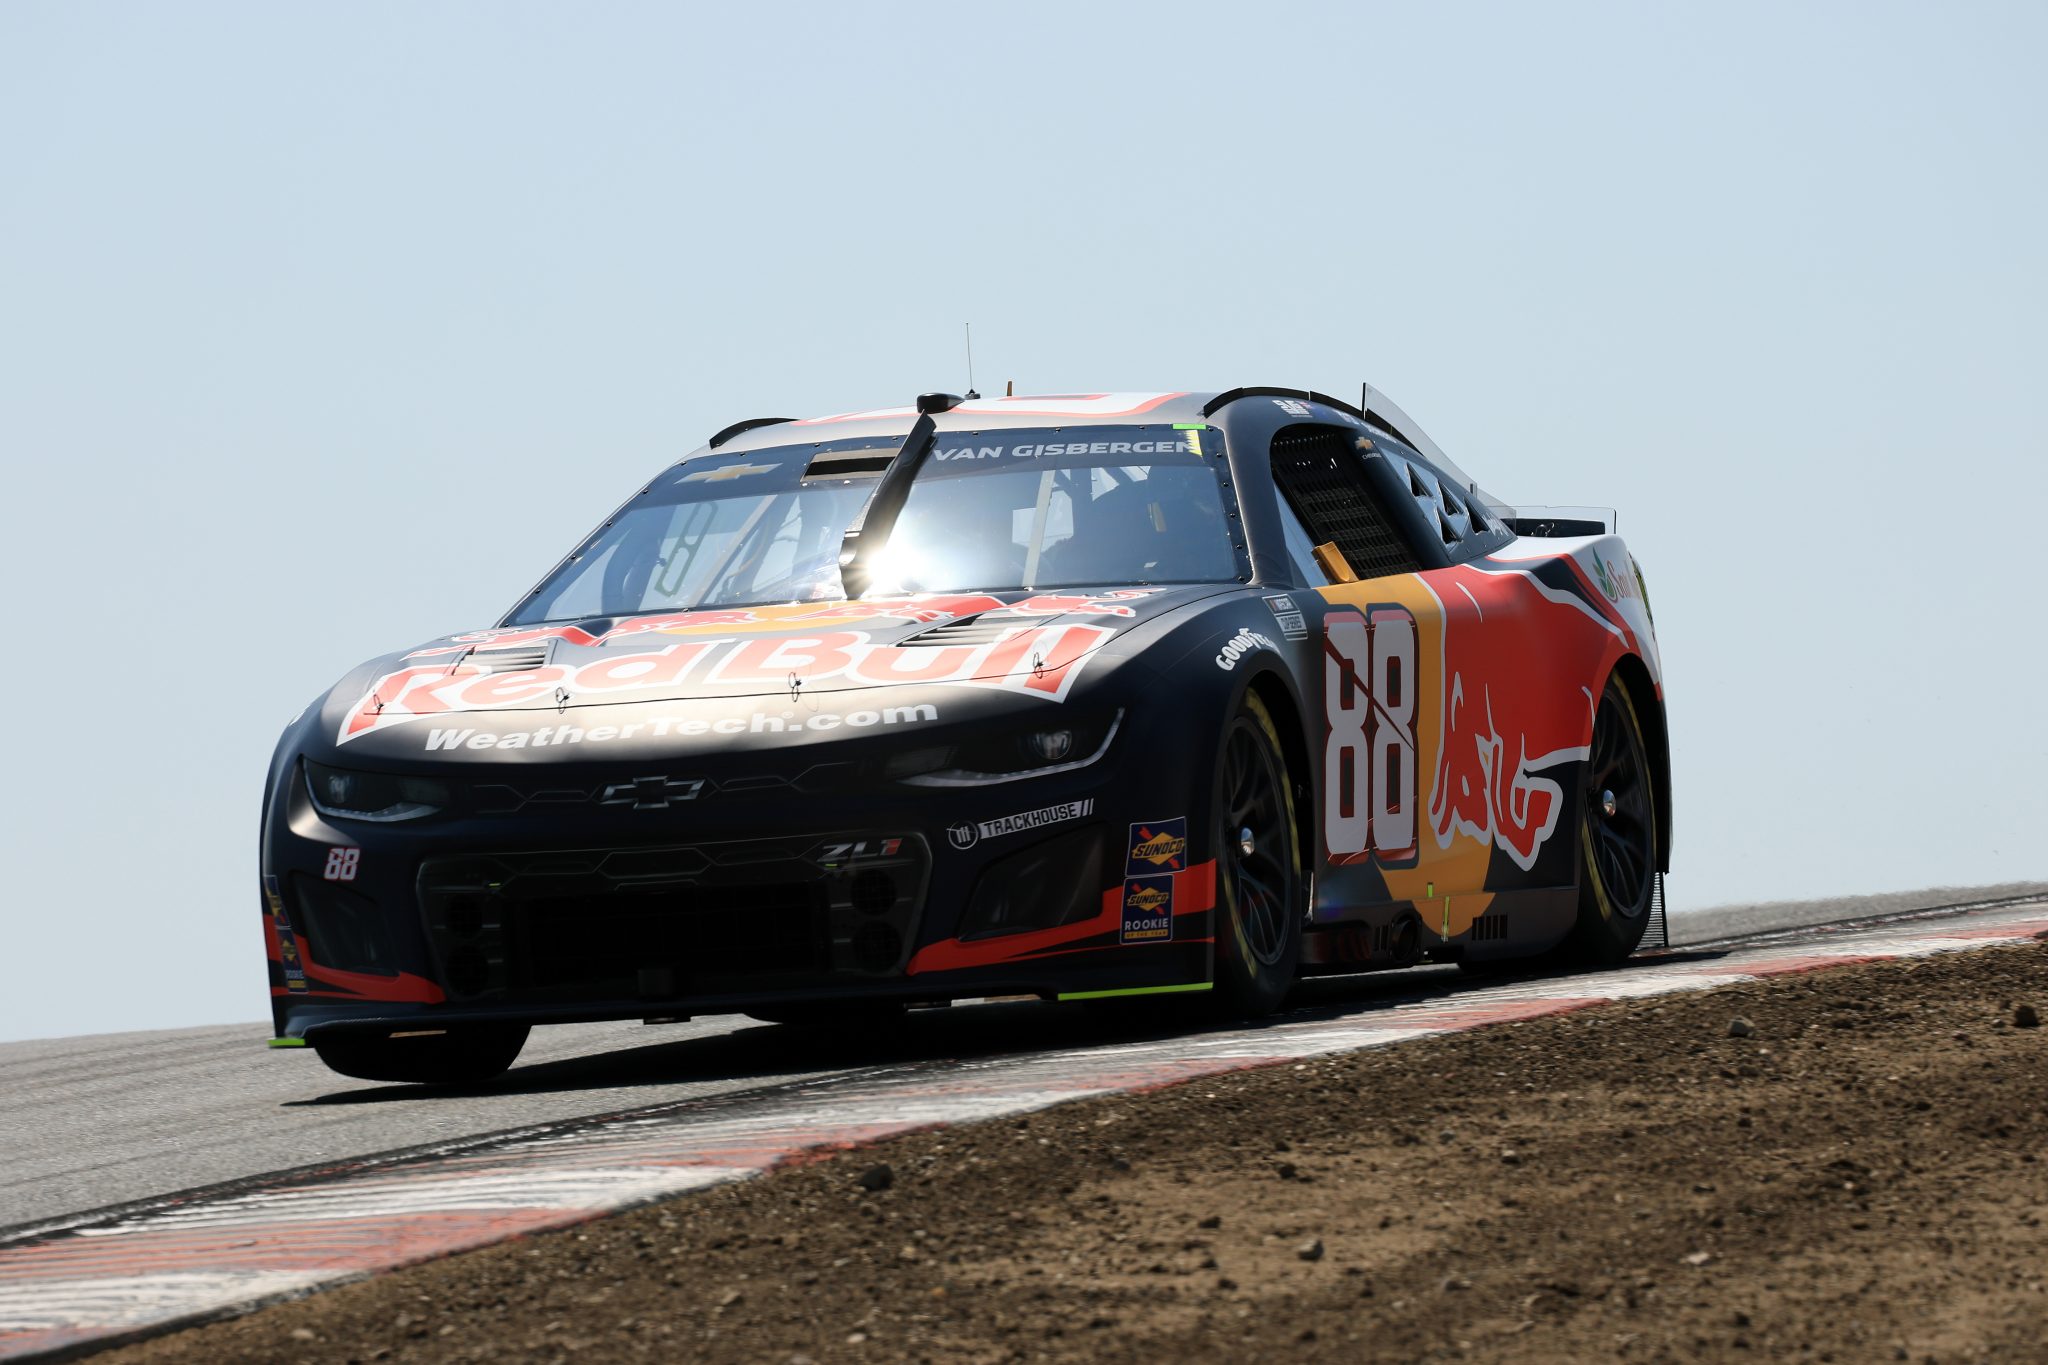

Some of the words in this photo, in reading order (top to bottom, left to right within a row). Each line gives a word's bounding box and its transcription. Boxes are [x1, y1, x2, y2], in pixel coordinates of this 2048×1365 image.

[933, 446, 1003, 461] VAN
[1011, 441, 1195, 458] GISBERGEN
[336, 637, 738, 748] Red
[714, 624, 1117, 704] Bull
[424, 703, 938, 751] WeatherTech.com
[1324, 610, 1418, 865] 88
[984, 804, 1077, 838] TRACKHOUSE
[816, 838, 903, 862] ZL1
[1134, 839, 1184, 858] SUNOCO
[323, 848, 360, 880] 88
[1129, 893, 1168, 906] SUNOCO
[1124, 918, 1169, 931] ROOKIE
